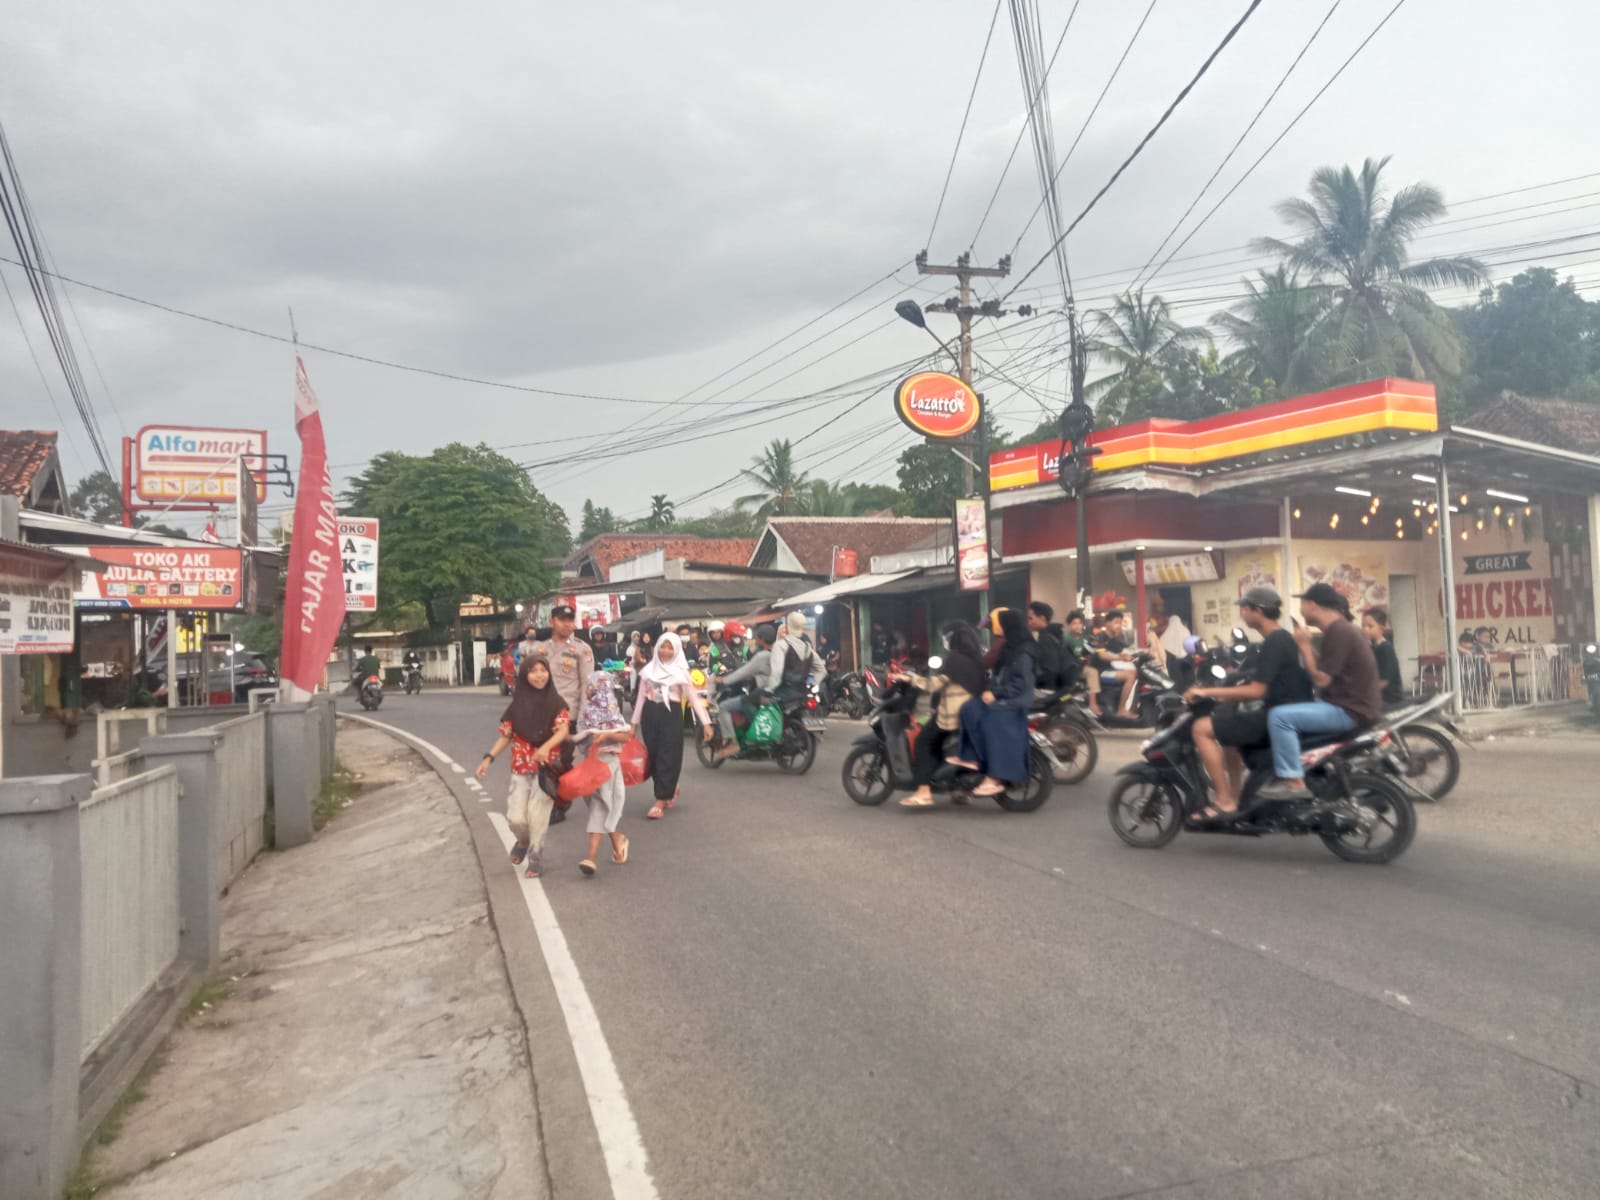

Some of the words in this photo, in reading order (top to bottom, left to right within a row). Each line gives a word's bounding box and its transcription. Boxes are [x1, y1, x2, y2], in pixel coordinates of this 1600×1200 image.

[910, 389, 958, 413] Lazatto
[148, 434, 255, 454] Alfamart
[340, 524, 366, 534] OKO
[133, 552, 178, 567] TOKO
[182, 553, 210, 567] AKI
[1475, 555, 1518, 570] GREAT
[102, 565, 156, 581] AULIA
[160, 567, 238, 581] BATTERY
[1504, 626, 1536, 643] ALL
